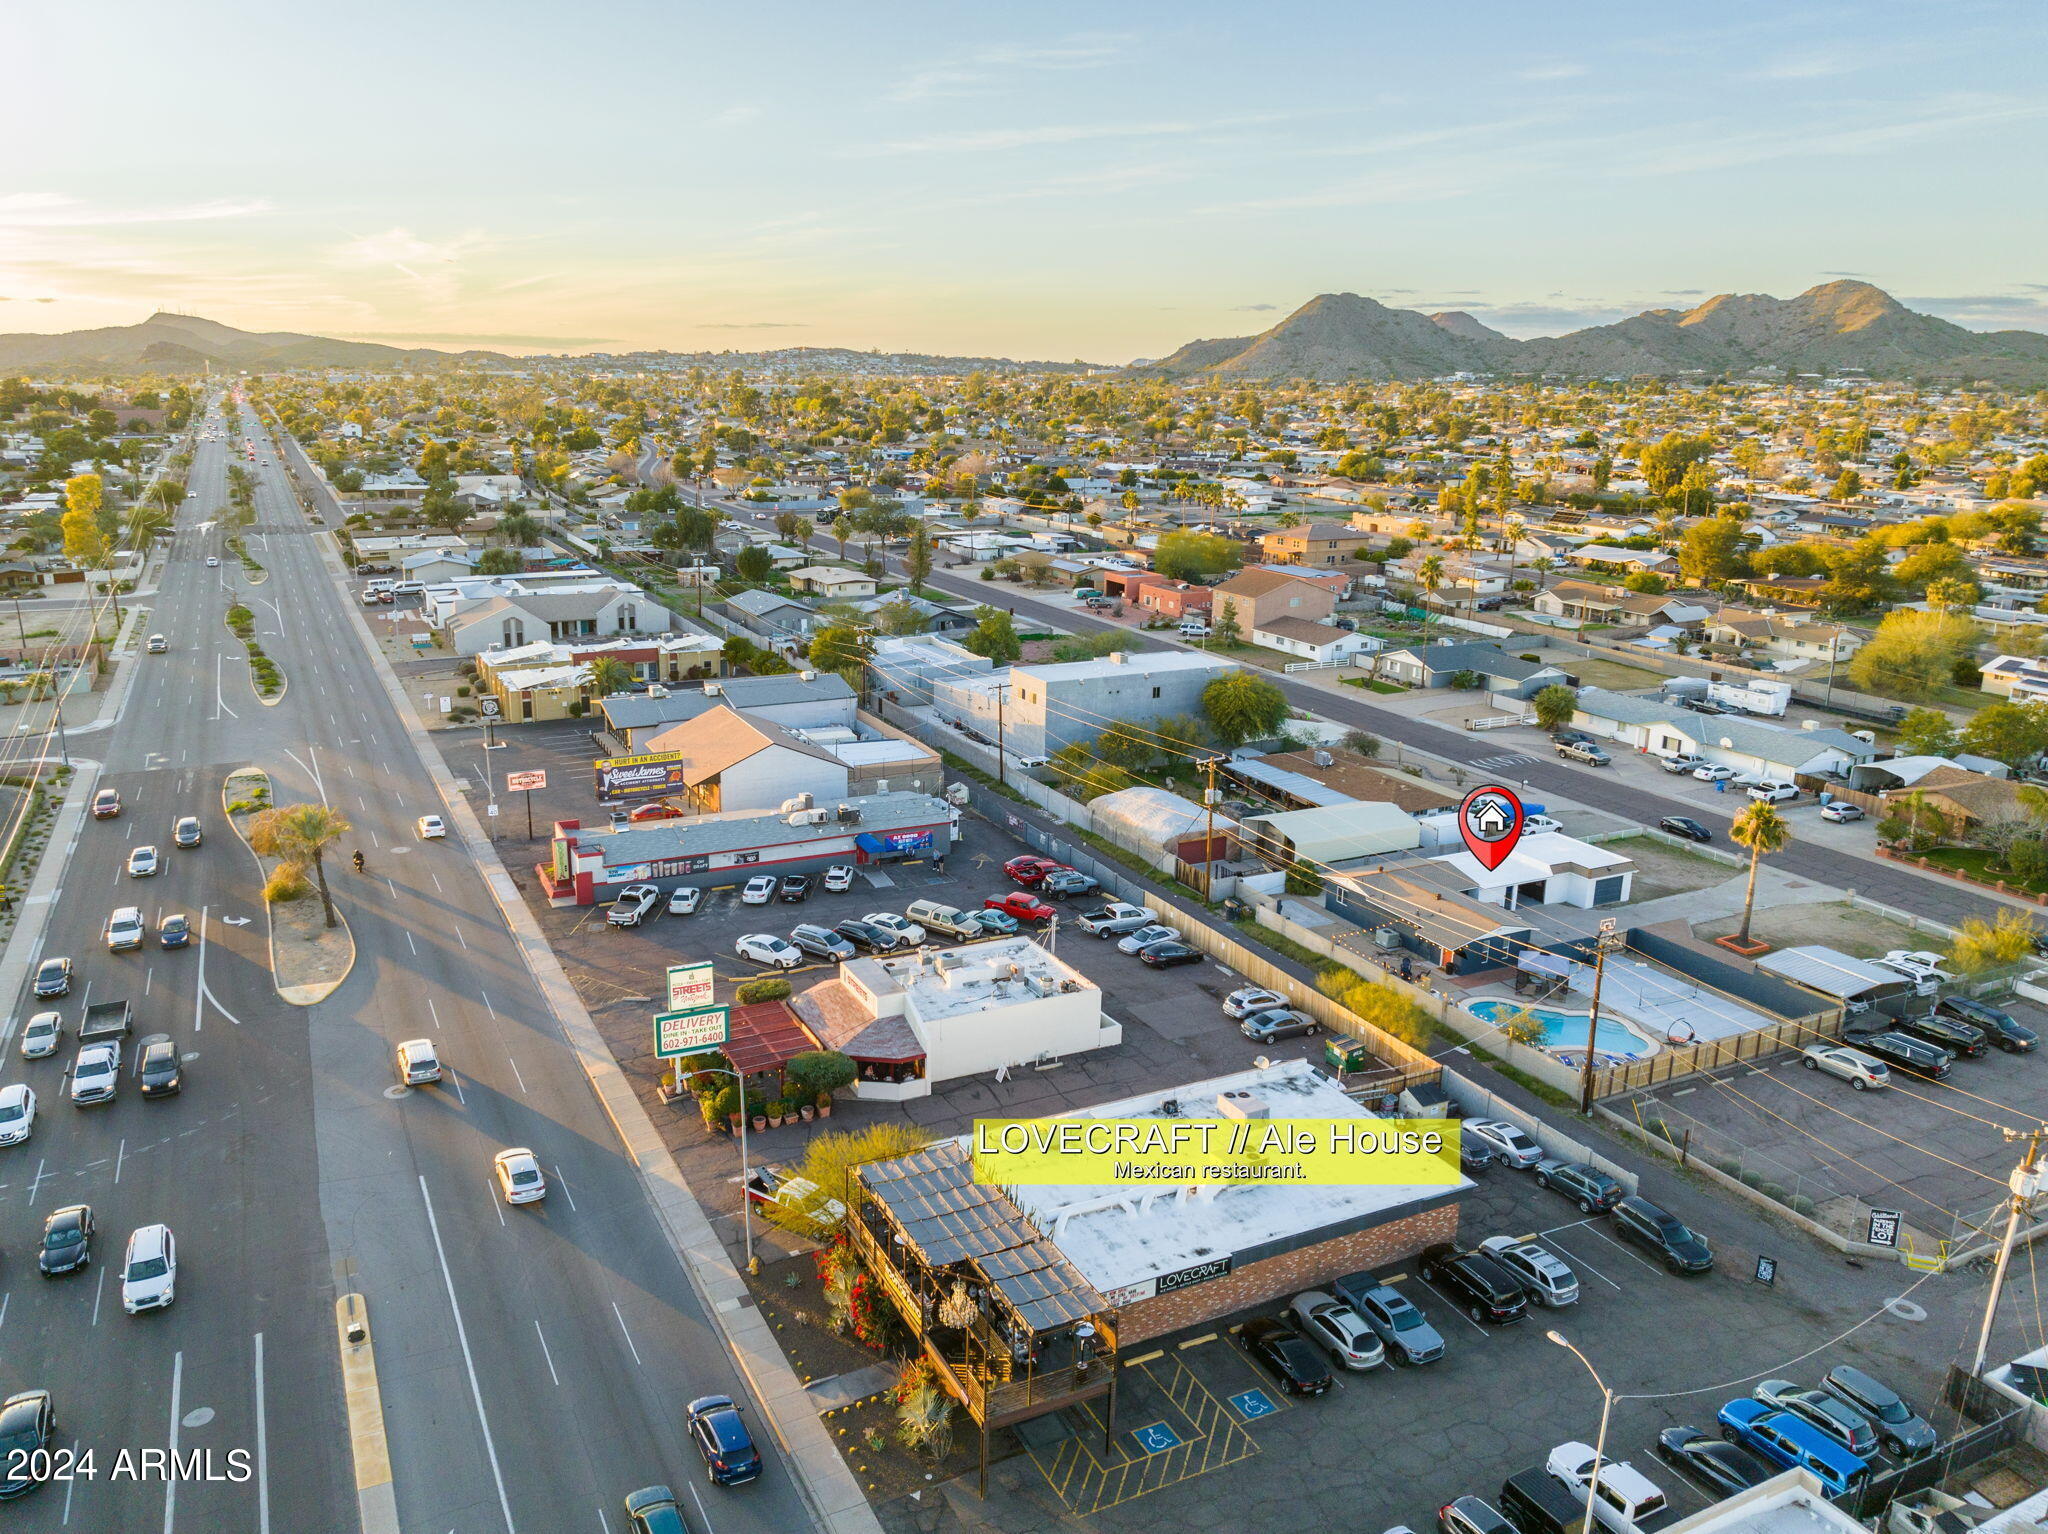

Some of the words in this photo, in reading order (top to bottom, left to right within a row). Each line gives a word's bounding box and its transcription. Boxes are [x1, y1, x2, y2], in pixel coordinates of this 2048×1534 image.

[649, 753, 681, 762] ACCIDENT?
[610, 767, 636, 780] Sweet
[636, 765, 667, 778] James
[672, 982, 711, 996] STREETS
[663, 1013, 722, 1033] DELIVERY
[692, 1026, 707, 1034] TAKE
[663, 1031, 723, 1050] 602-971-6400
[1871, 1231, 1894, 1240] LOT
[1160, 1259, 1228, 1289] LOVECRAFT
